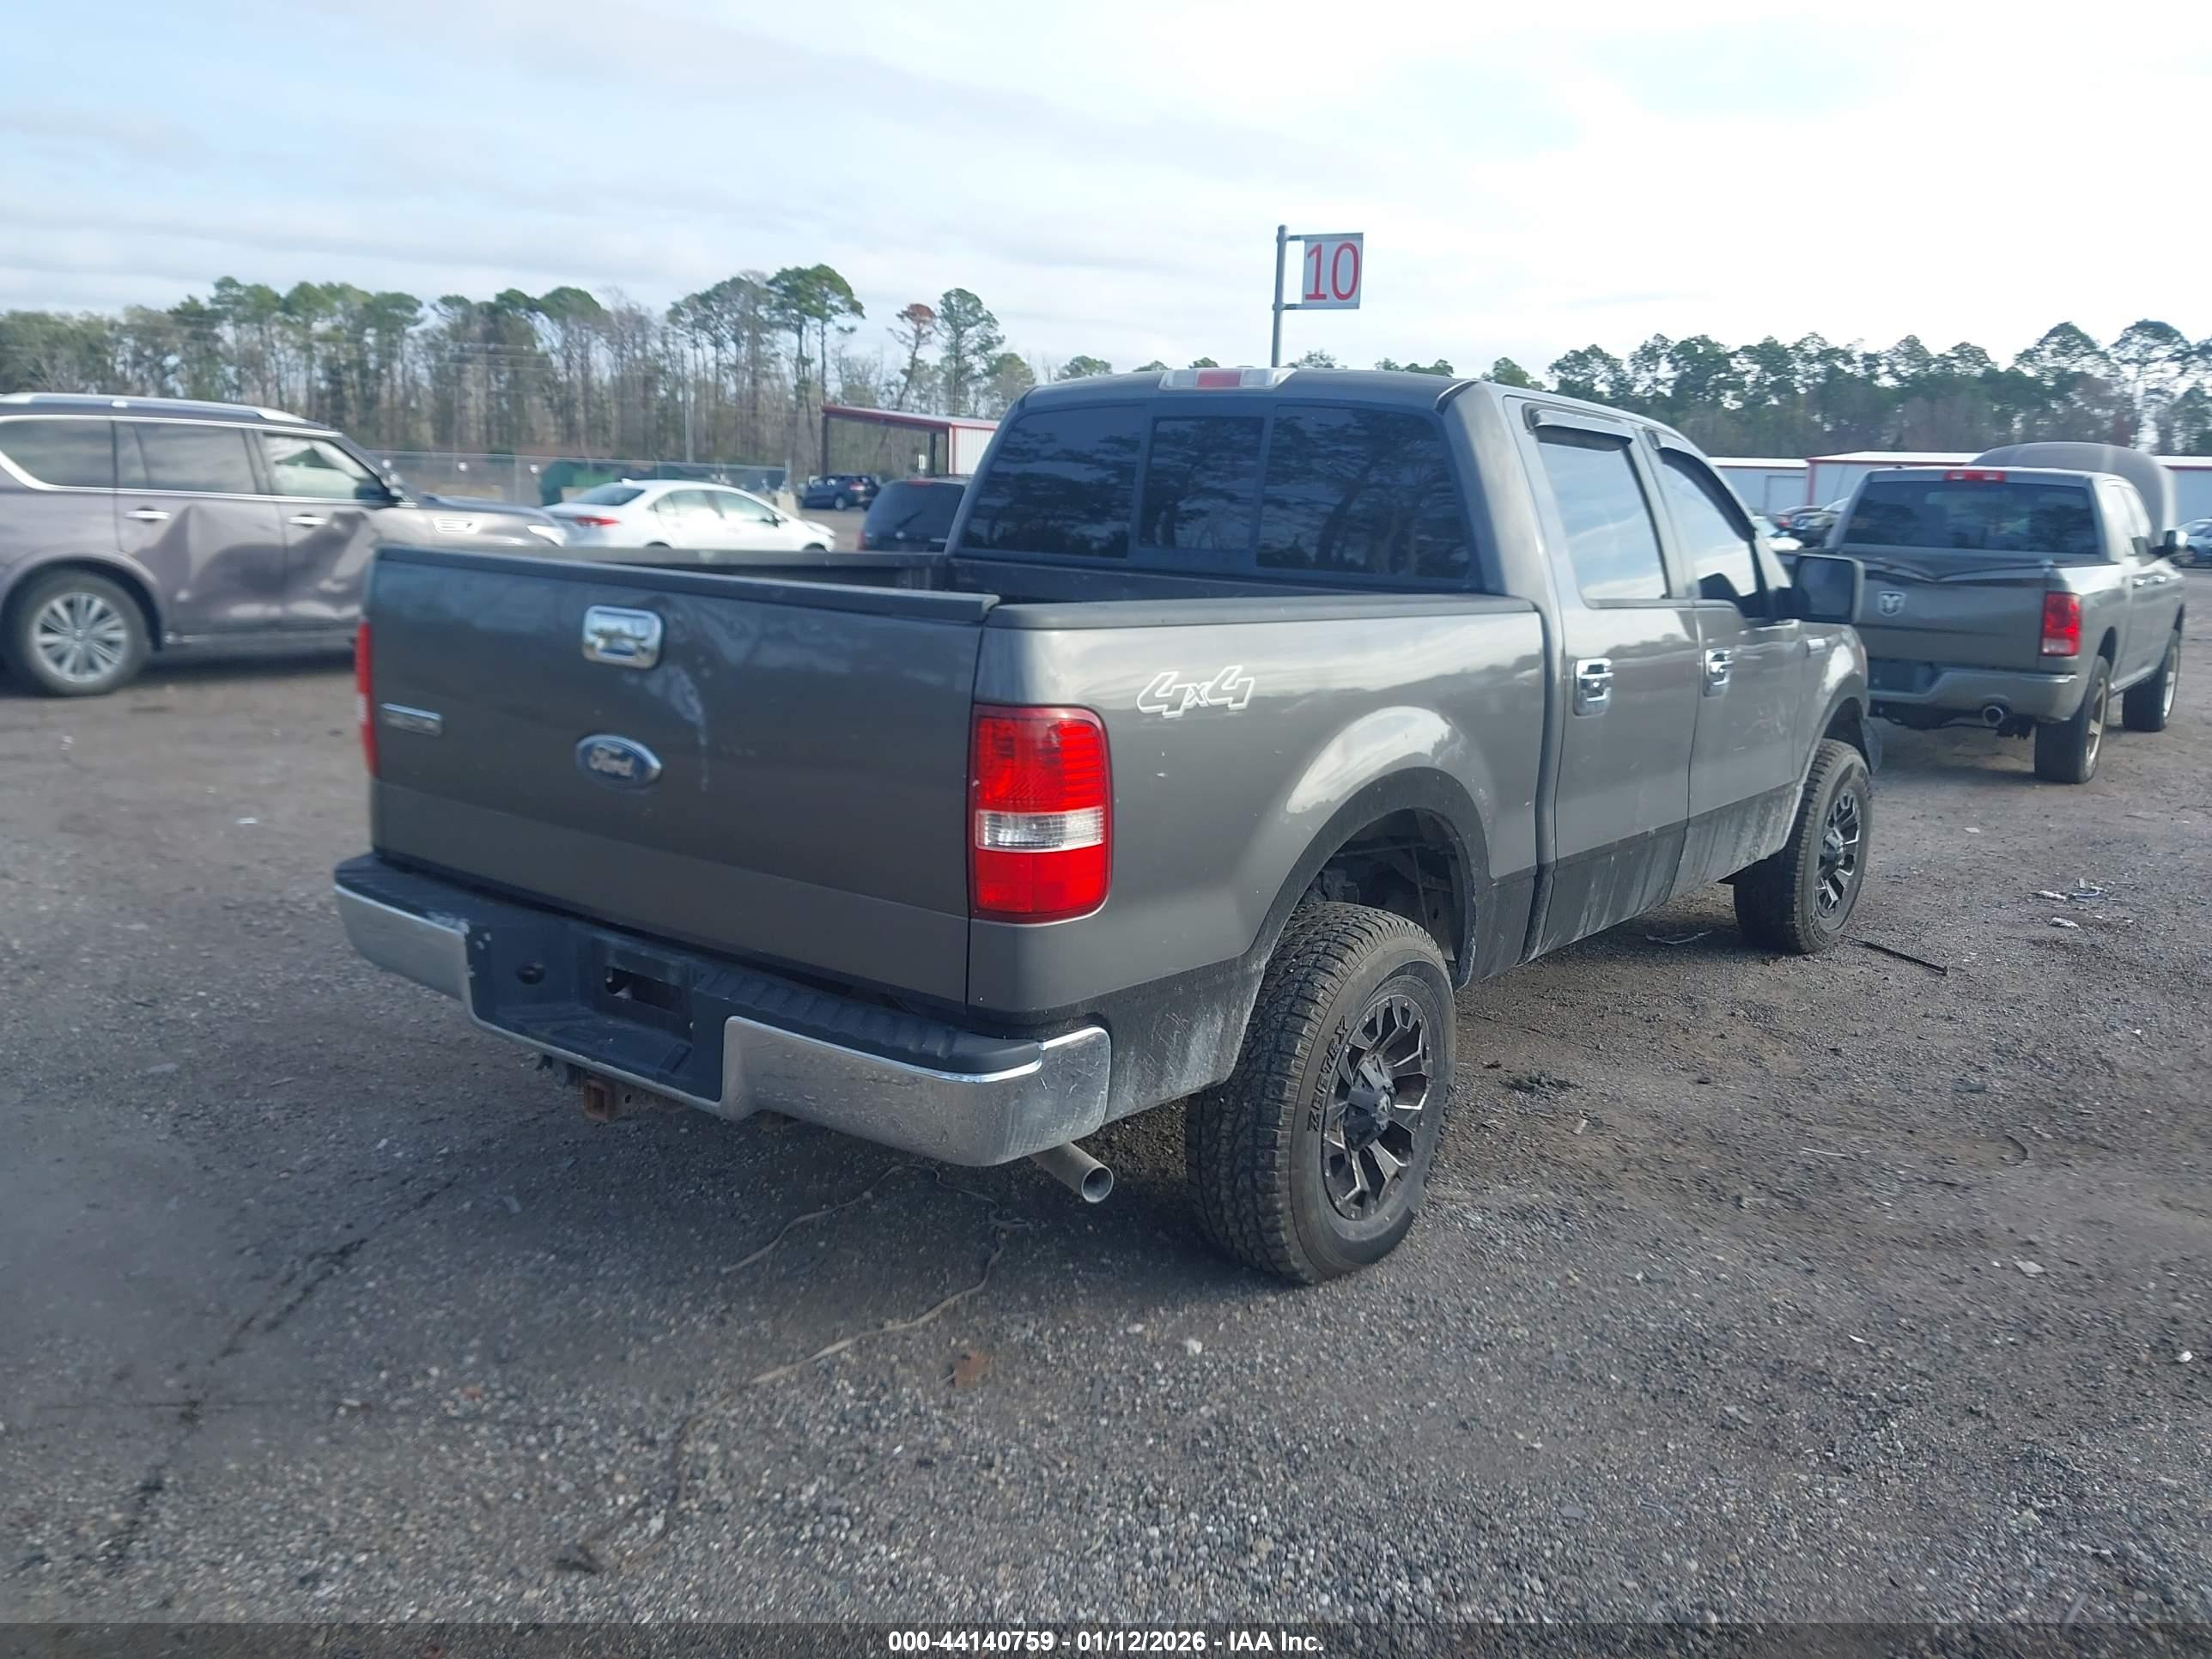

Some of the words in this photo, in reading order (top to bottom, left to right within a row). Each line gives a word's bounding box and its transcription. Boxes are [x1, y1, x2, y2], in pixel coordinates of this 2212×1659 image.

[1305, 242, 1358, 301] 10
[1137, 665, 1255, 719] 4x4
[1307, 1014, 1349, 1133] ZEETEX
